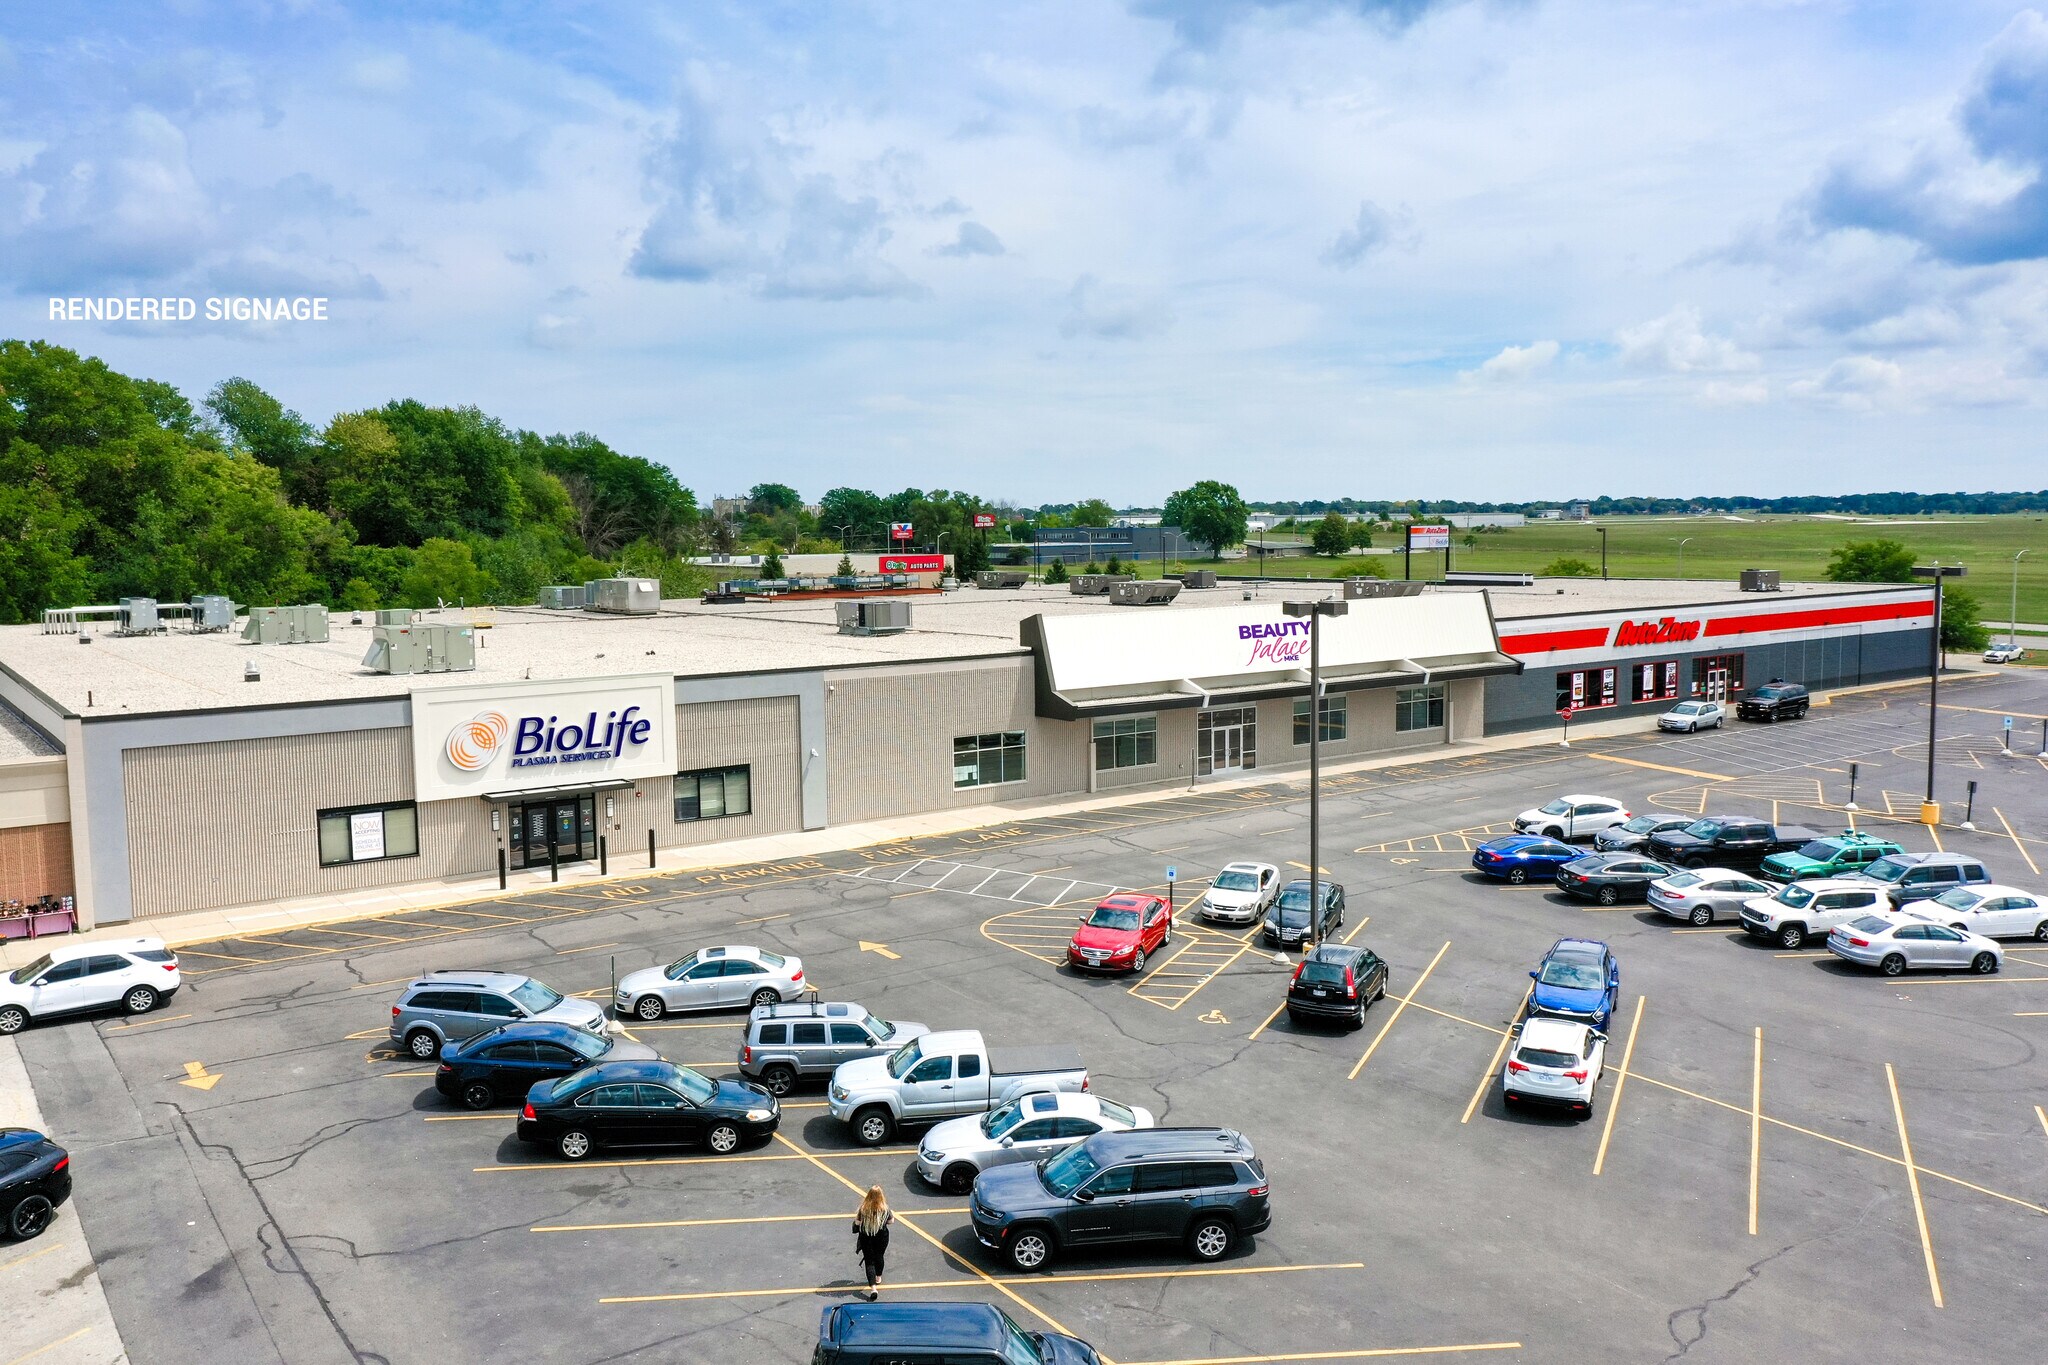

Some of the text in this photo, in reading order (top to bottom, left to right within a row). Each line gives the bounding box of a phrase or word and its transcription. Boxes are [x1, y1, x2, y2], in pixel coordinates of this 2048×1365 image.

[1238, 620, 1311, 639] BEAUTY
[1613, 616, 1701, 647] AutoZone
[1246, 637, 1311, 666] Palace
[513, 706, 651, 758] BioLife
[512, 750, 612, 767] PLASMA SERVICES
[353, 820, 380, 831] NOW
[601, 827, 1032, 898] NO PARKING FIRE LANE
